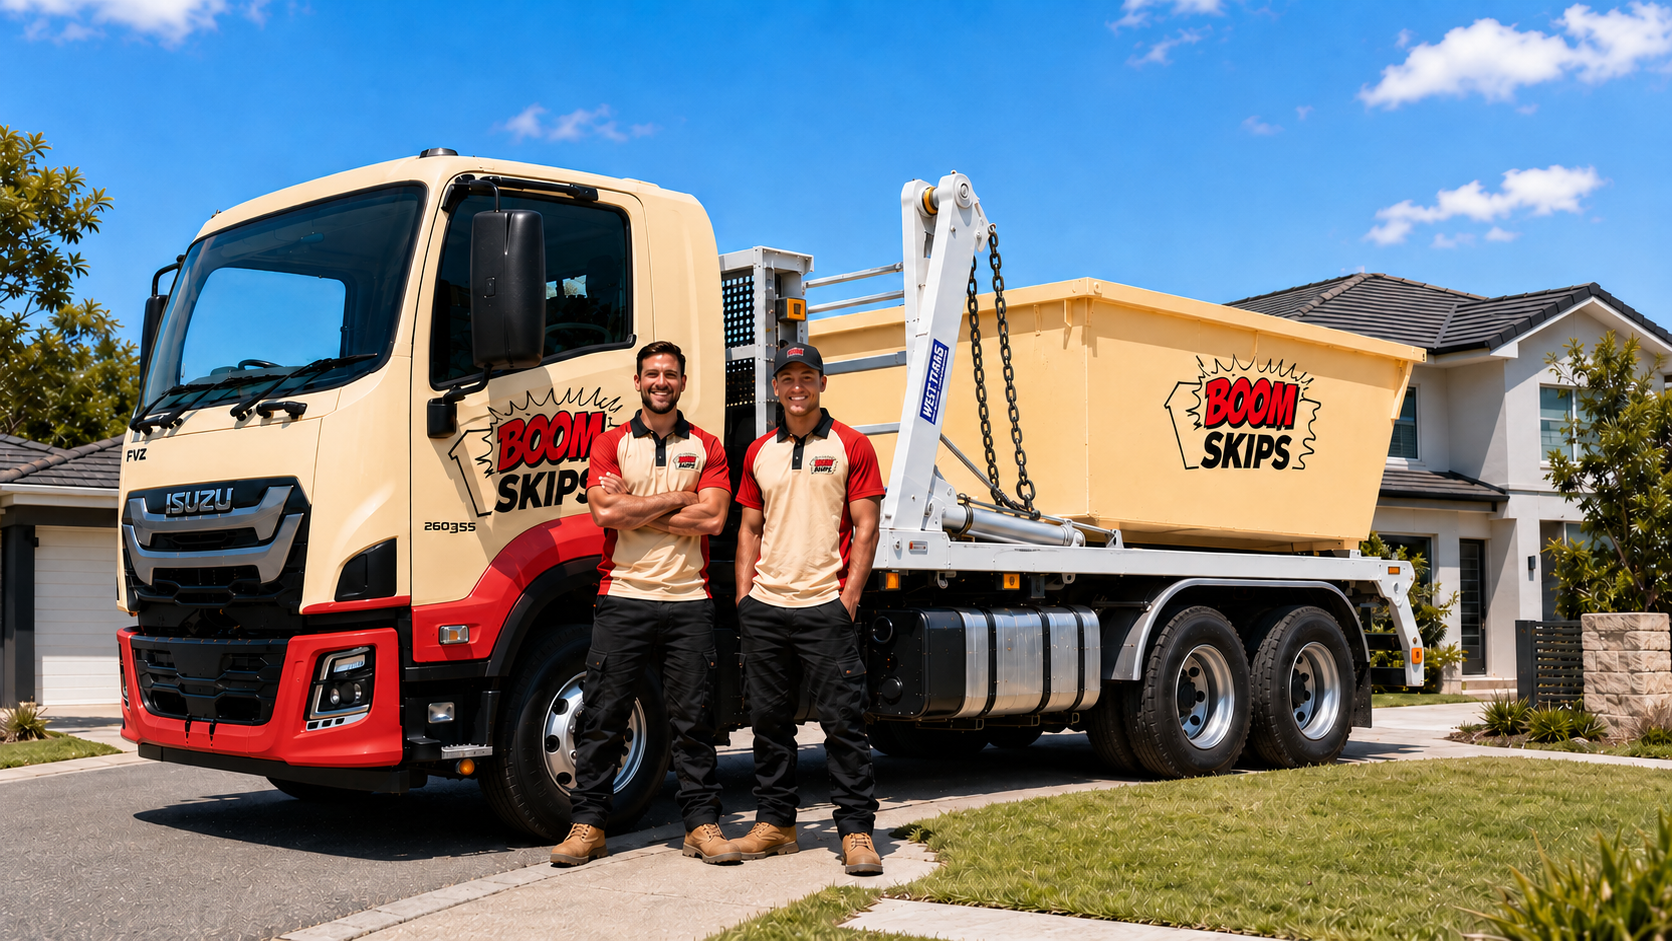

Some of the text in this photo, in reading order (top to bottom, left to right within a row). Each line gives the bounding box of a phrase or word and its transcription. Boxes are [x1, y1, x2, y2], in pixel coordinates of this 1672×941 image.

[1204, 377, 1300, 430] BOOM
[126, 448, 147, 462] FVZ
[498, 410, 607, 473] BOOM
[1201, 431, 1293, 470] SKIPS
[166, 488, 233, 513] ISUZU
